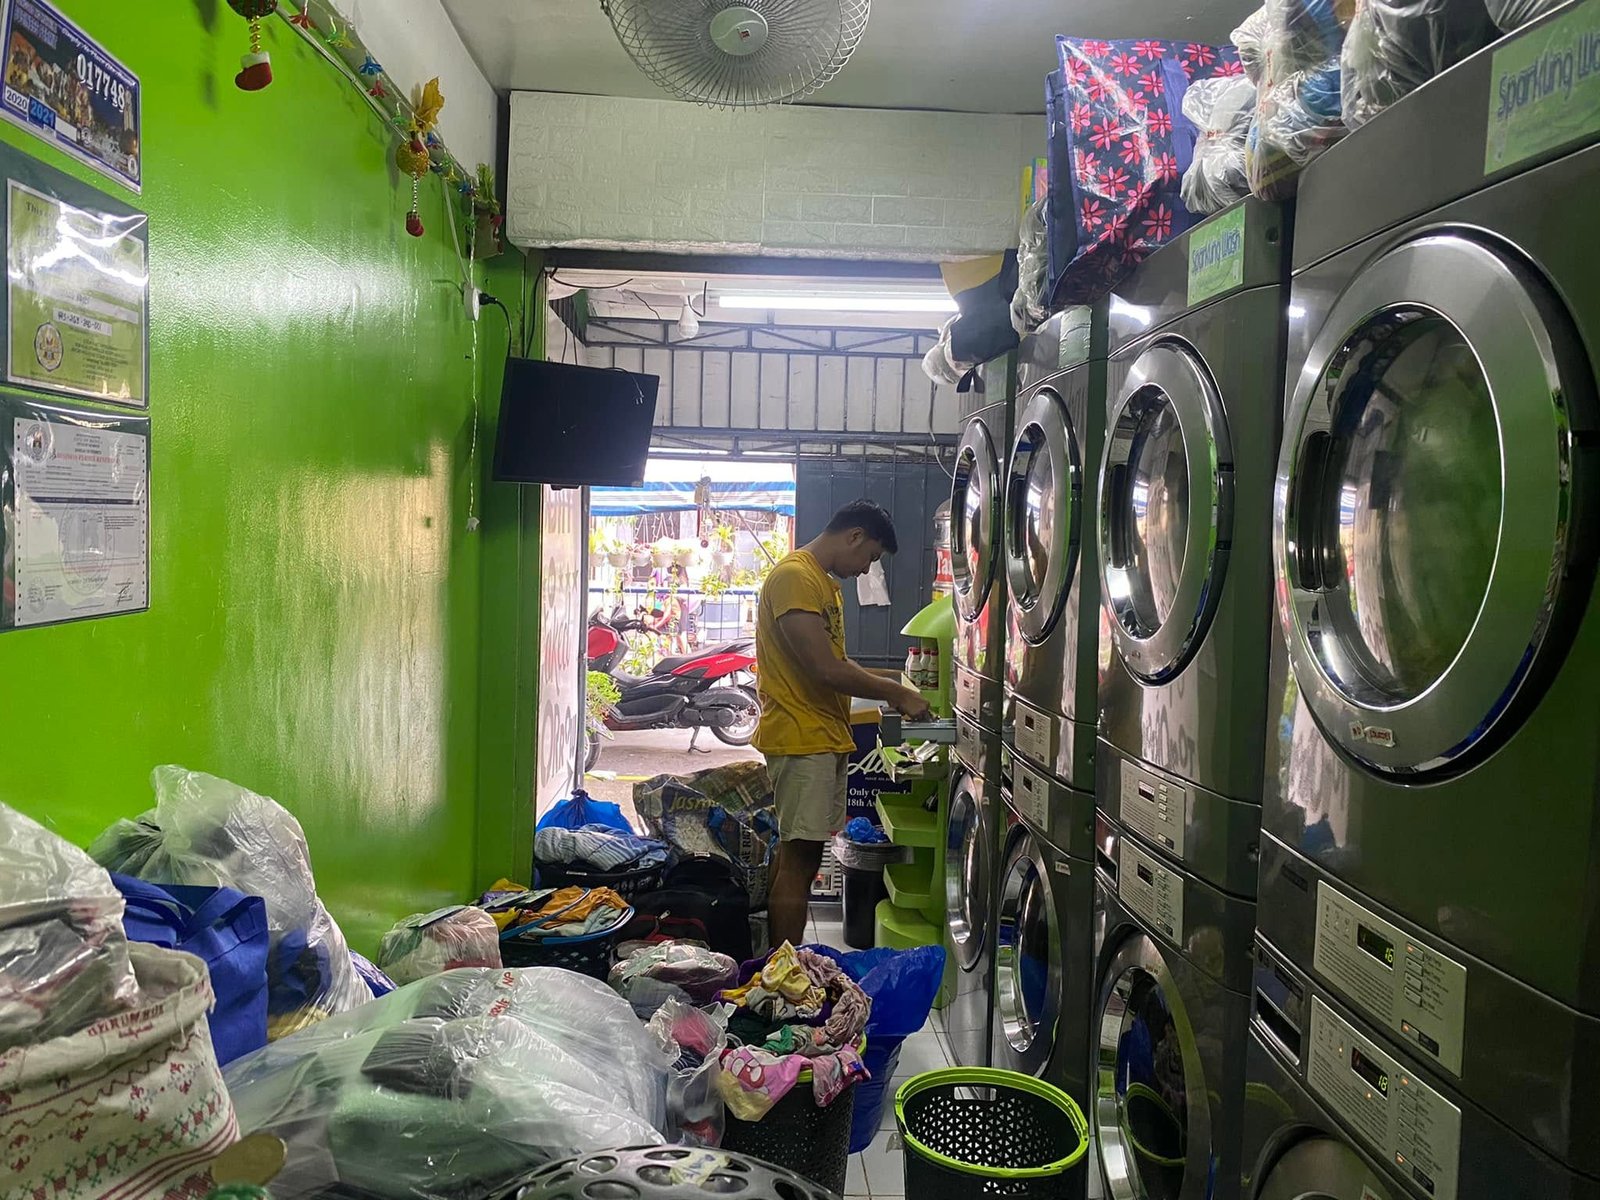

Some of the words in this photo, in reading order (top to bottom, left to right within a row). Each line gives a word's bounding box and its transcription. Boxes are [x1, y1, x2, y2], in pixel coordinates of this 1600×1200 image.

[76, 53, 126, 113] 017748
[1497, 51, 1573, 120] Sparkling
[6, 89, 28, 111] 2020
[30, 99, 56, 127] 2021
[1222, 228, 1240, 258] Wash
[848, 798, 865, 808] 18th
[849, 787, 870, 799] Only
[1385, 947, 1394, 963] 16
[1378, 1074, 1388, 1092] 18
